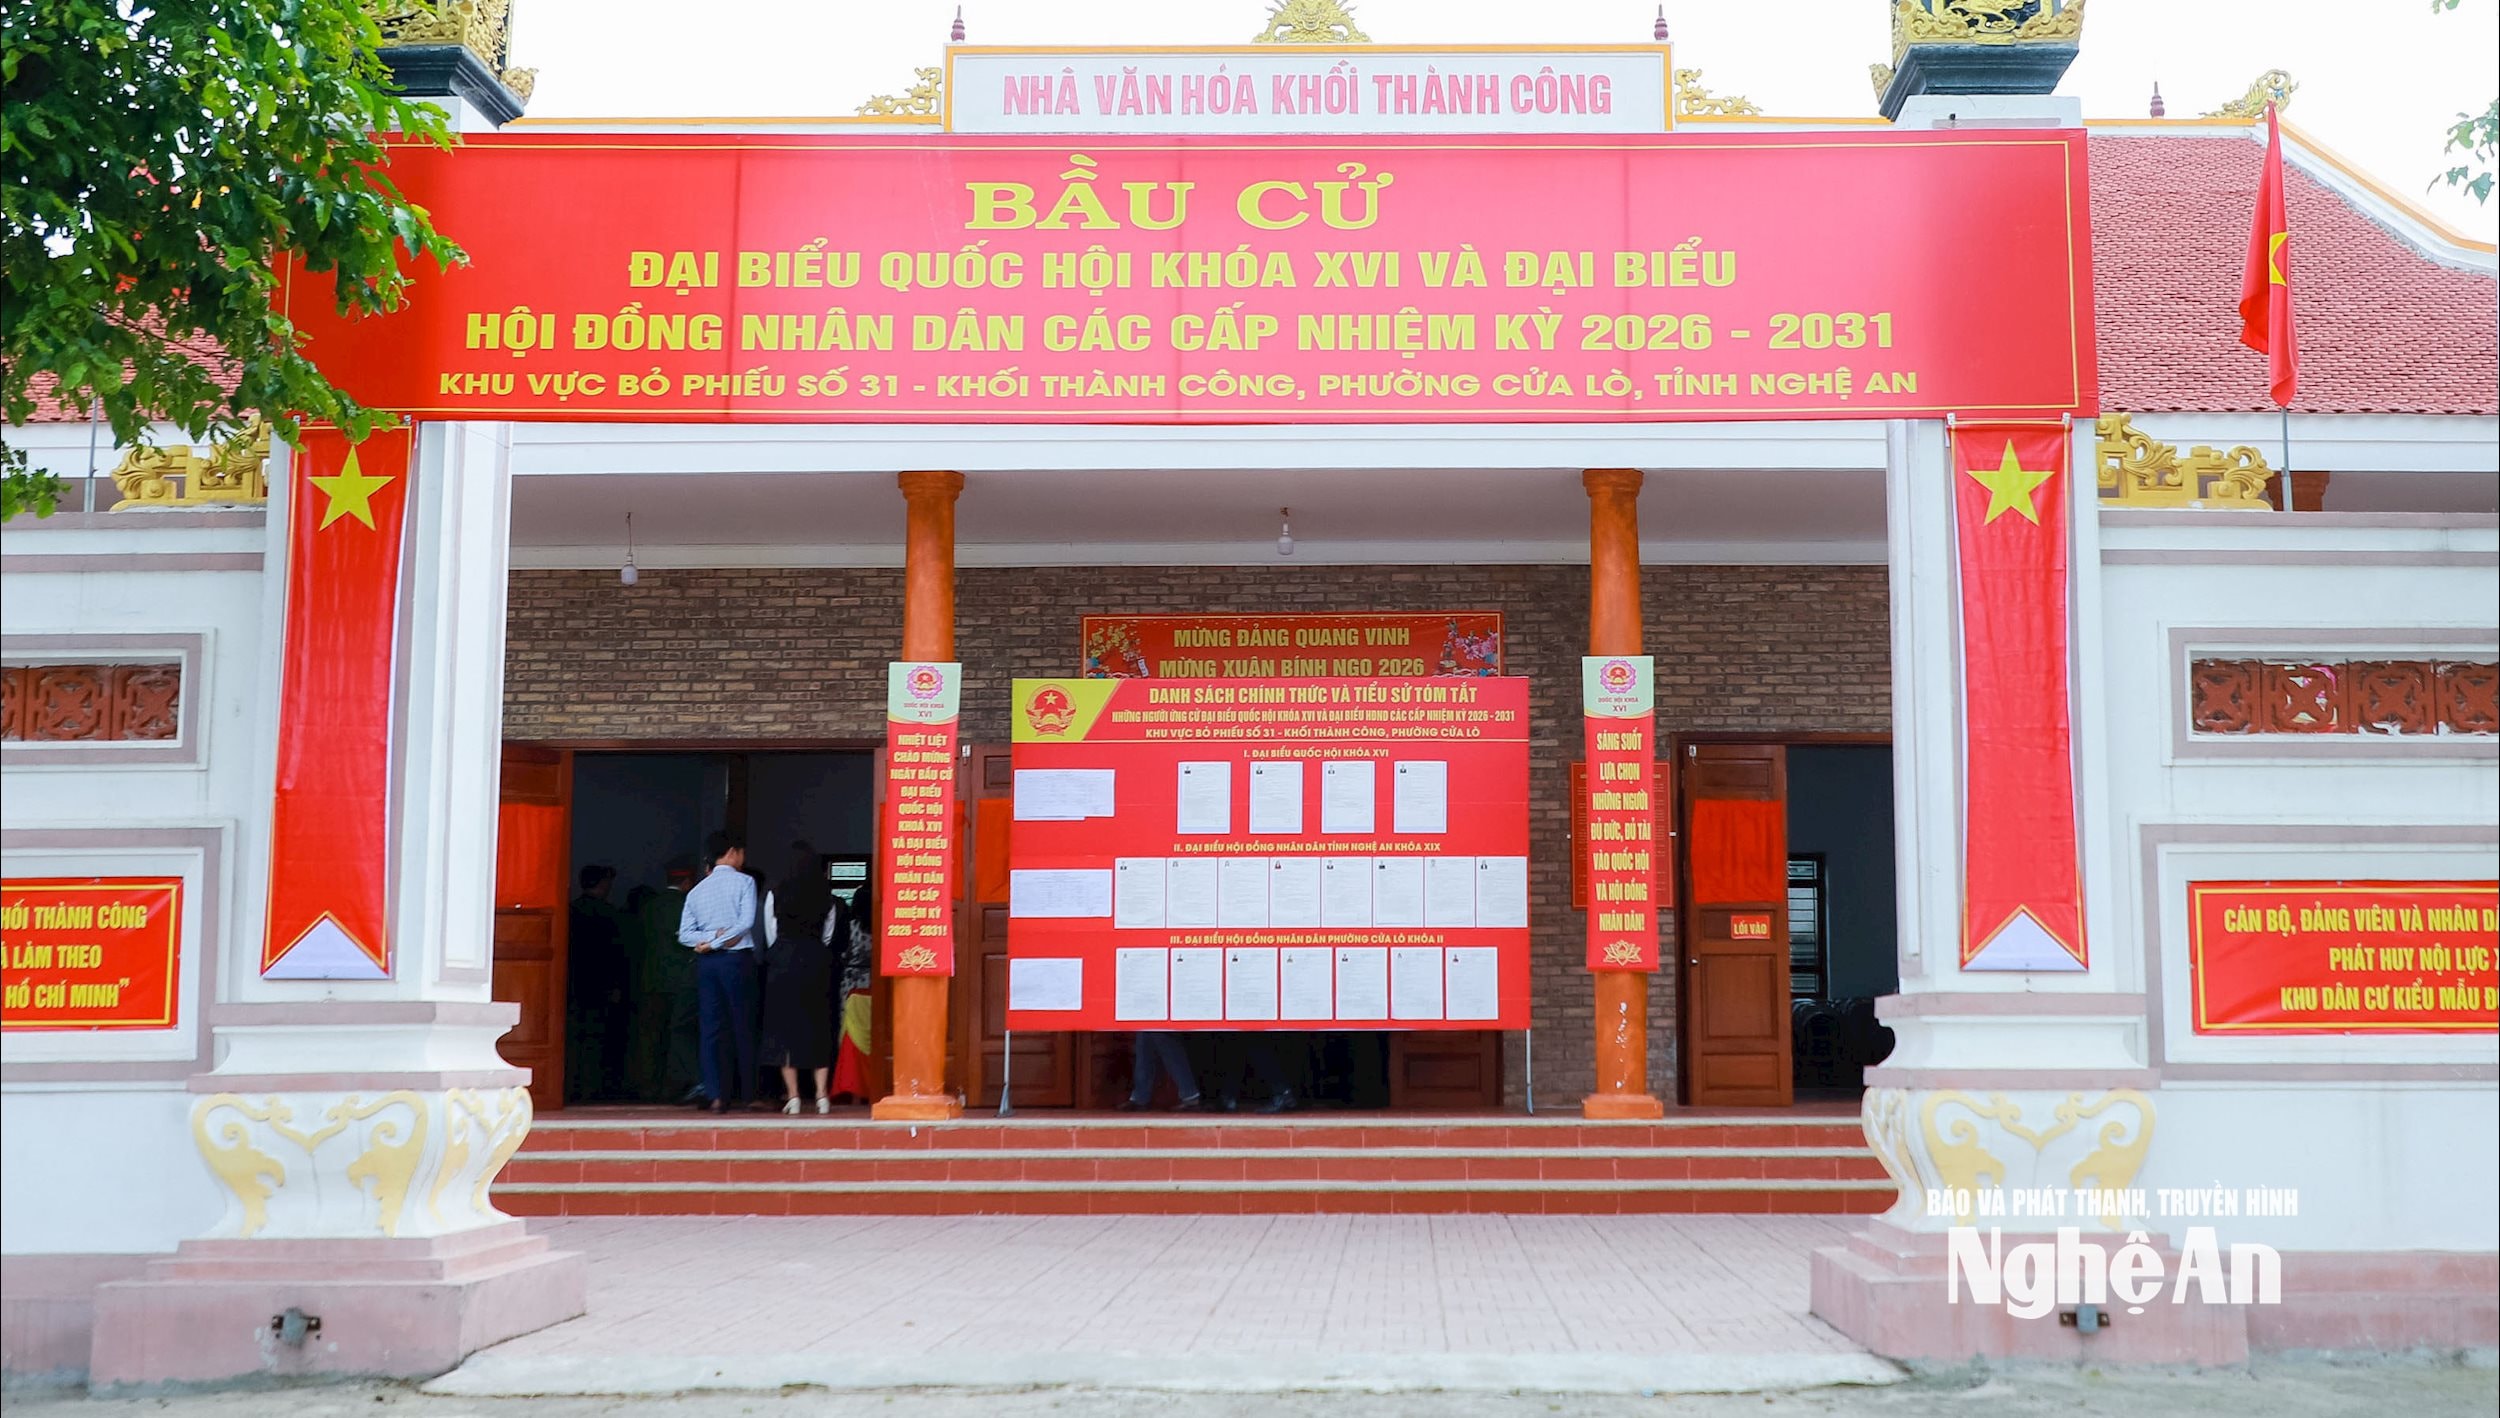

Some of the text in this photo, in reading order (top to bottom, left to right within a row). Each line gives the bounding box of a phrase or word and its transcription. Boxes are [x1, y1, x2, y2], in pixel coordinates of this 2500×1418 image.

[1094, 66, 1172, 115] VĂN
[1182, 63, 1258, 115] HÓA
[1372, 64, 1500, 115] THÀNH
[1510, 66, 1612, 115] CÔNG
[964, 153, 1394, 230] BẦU CỬ
[628, 236, 1737, 296] ĐẠI BIỂU QUỐC HỘI KHÓA XVI VÀ ĐẠI BIỂU
[465, 306, 555, 358] HỘI
[572, 302, 723, 352] ĐỒNG
[741, 307, 893, 352] NHÂN
[912, 307, 1024, 352] DÂN
[1043, 307, 1151, 352] CÁC
[1170, 302, 1279, 352] CẤP
[1298, 307, 1476, 359] NHIỆM
[1494, 306, 1564, 351] KỲ
[1580, 314, 1713, 351] 2026
[1768, 312, 1893, 350] 2031
[439, 373, 514, 396] KHU
[527, 369, 607, 401] VỰC
[618, 366, 671, 397] BỎ
[682, 365, 786, 397] PHIẾU
[797, 365, 849, 397] SỐ
[859, 375, 899, 397] 31
[936, 366, 1029, 398] KHỐI
[1040, 369, 1166, 398] THÀNH
[1178, 369, 1306, 400] CÔNG,
[1318, 369, 1480, 398] PHƯỜNG
[1492, 366, 1574, 397] CỬA
[1585, 368, 1643, 400] LÒ,
[1654, 366, 1738, 397] TỈNH
[1750, 368, 1853, 400] NGHỆ
[1864, 372, 1918, 395] AN
[1174, 623, 1410, 648] MỪNG ĐẢNG QUANG VINH
[1159, 656, 1217, 678] MỪNG
[1222, 656, 1275, 678] XUÂN
[1280, 655, 1327, 677] BÍNH
[1378, 658, 1425, 677] 2026
[1149, 680, 1478, 704] DANH SÁCH CHÍNH THỨC VÀ TIỂU SỬ TÓM TẮT
[1145, 728, 1168, 738] KHU
[1169, 727, 1194, 740] VỰC
[1194, 726, 1211, 738] BỎ
[1213, 725, 1244, 738] PHIẾU
[1245, 725, 1262, 737] SỐ
[1263, 728, 1275, 737] 31
[1284, 725, 1311, 737] KHỐI
[1313, 726, 1350, 737] THÀNH
[1351, 726, 1389, 738] CÔNG,
[1391, 726, 1438, 737] PHƯỜNG
[1440, 725, 1464, 737] CỬA
[1466, 726, 1481, 737] LÒ
[1596, 727, 1642, 751] SÁNG SUỐT
[1599, 762, 1640, 784] LỰA CHỌN
[2223, 901, 2499, 937] CÁN BỘ, ĐẢNG VIÊN VÀ NHÂN D
[2329, 943, 2375, 972] PHÁT
[2379, 948, 2415, 971] HUY
[2420, 942, 2451, 976] NỘI
[2455, 945, 2490, 976] LỰC
[34, 979, 68, 1008] CHÍ
[2280, 987, 2319, 1010] KHU
[2322, 982, 2360, 1010] DÂN
[2364, 985, 2390, 1010] CƯ
[2393, 978, 2435, 1010] KIỂU
[2439, 977, 2480, 1010] MẪU
